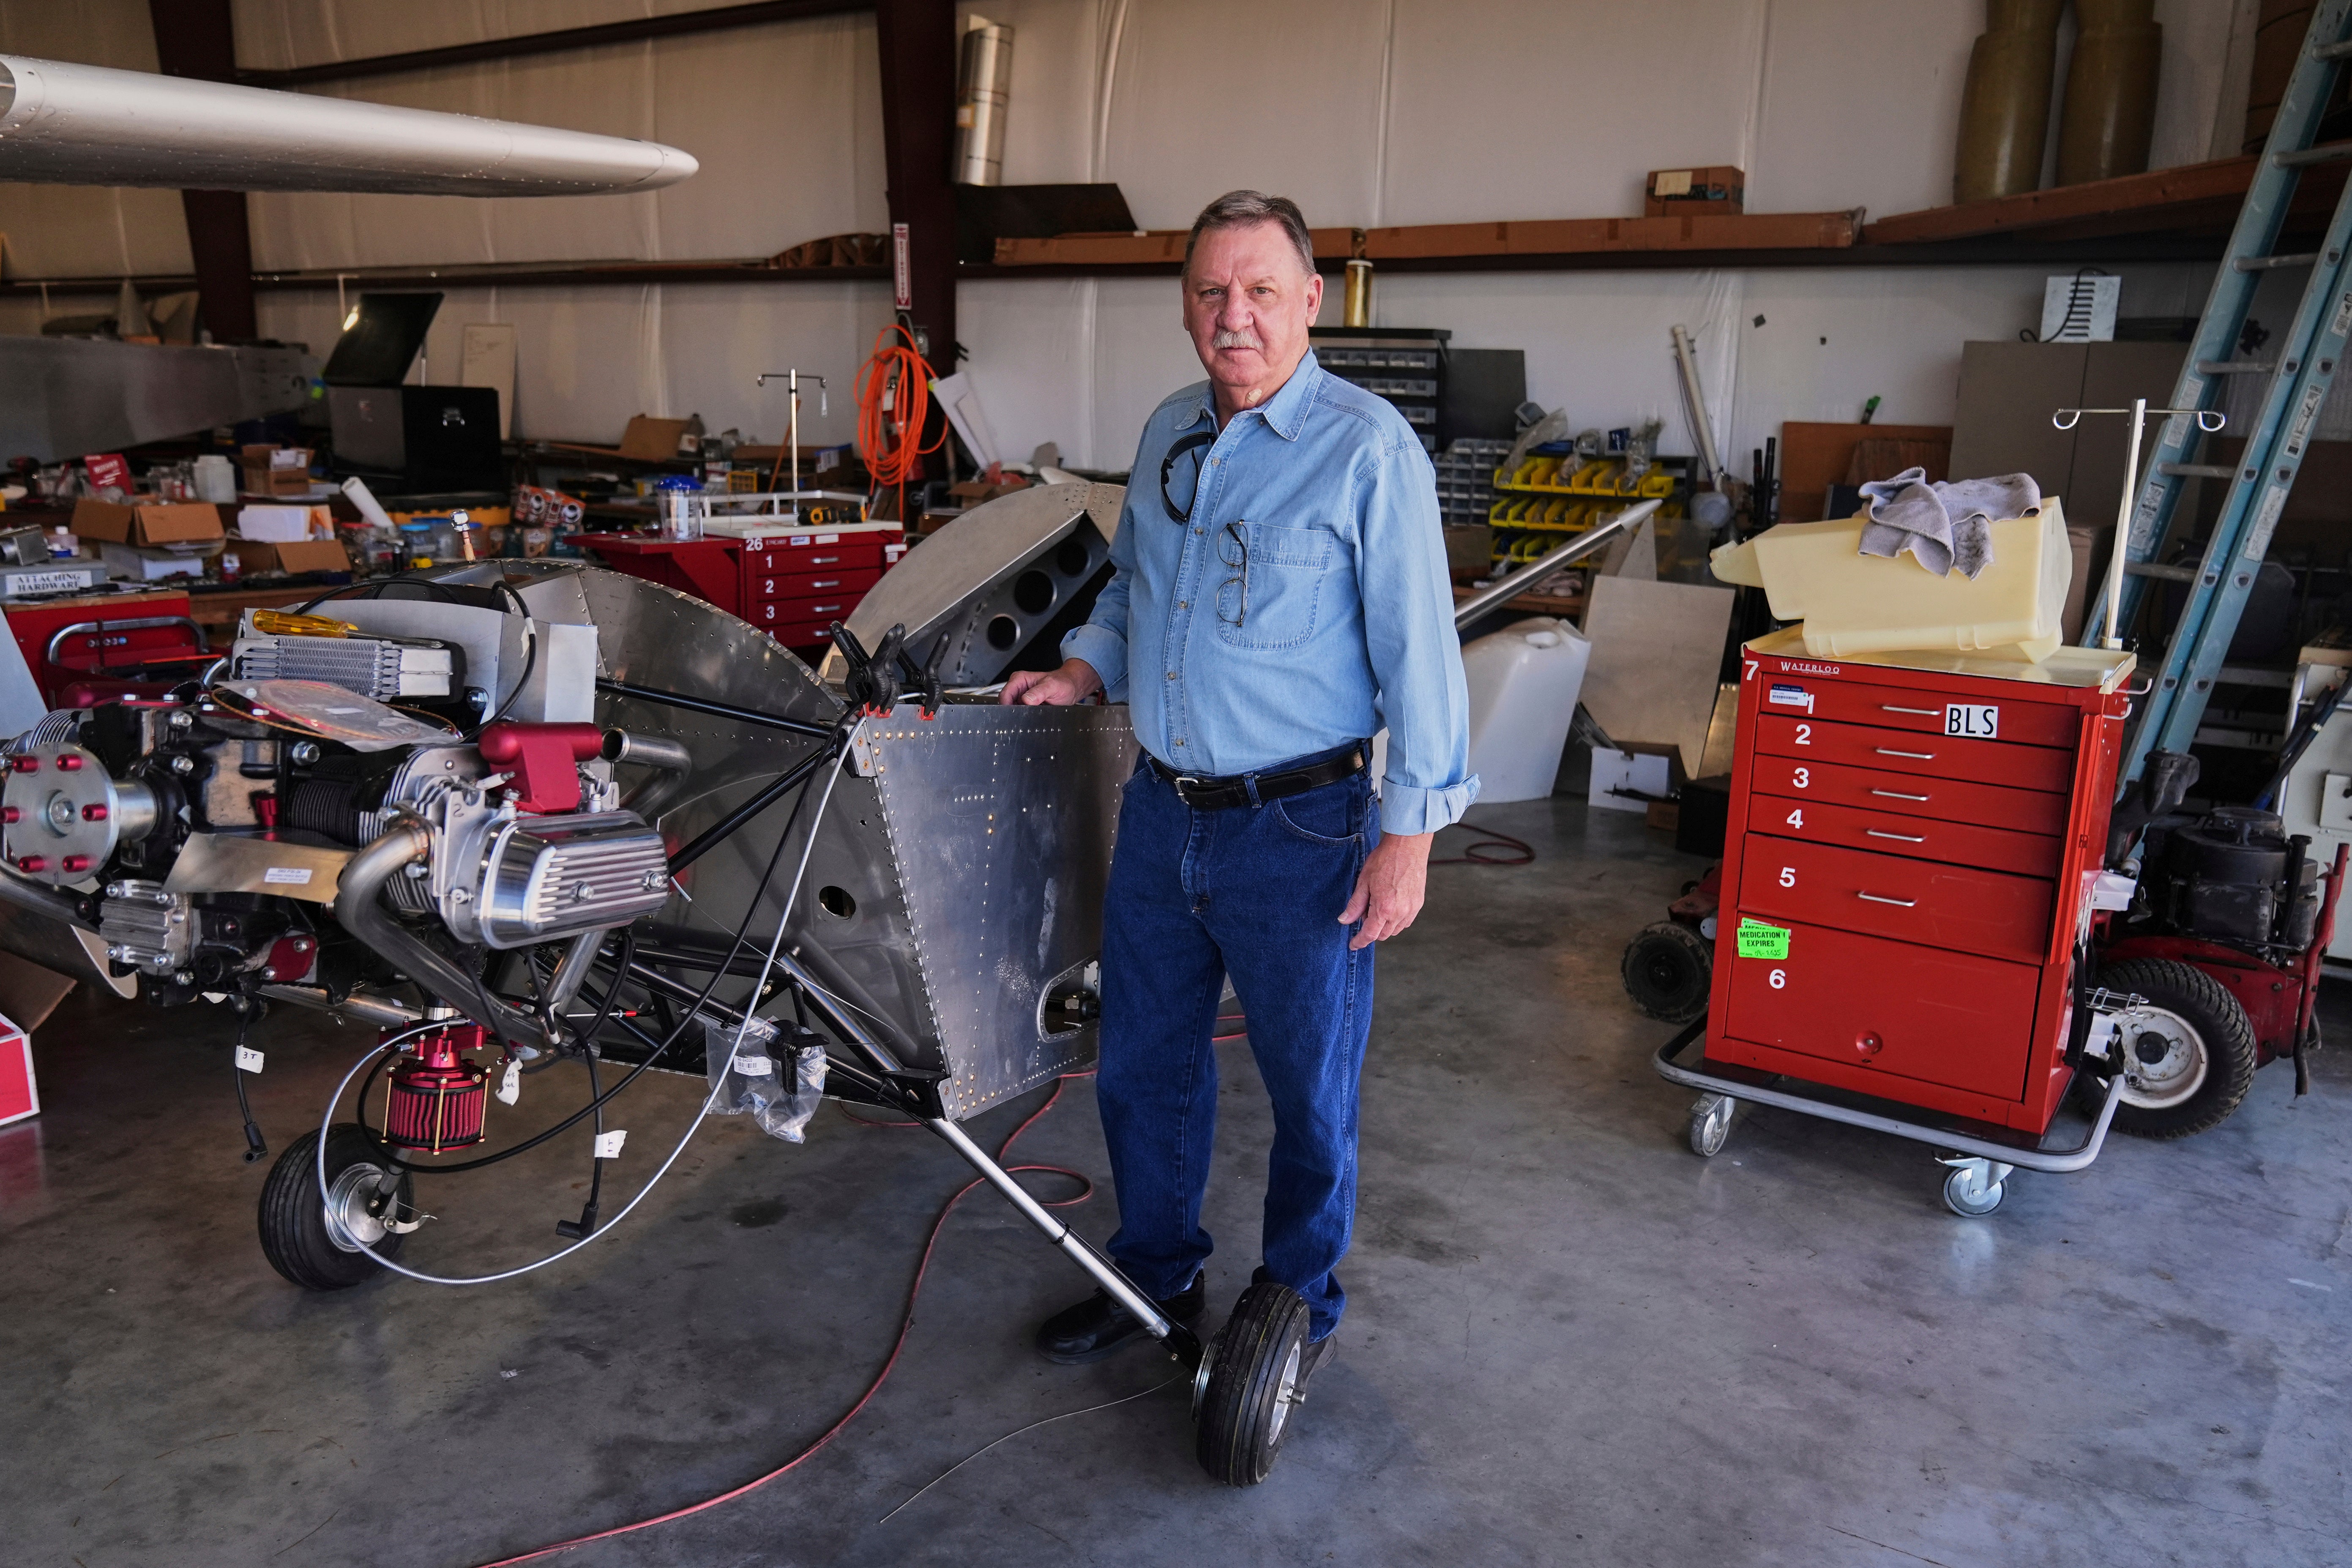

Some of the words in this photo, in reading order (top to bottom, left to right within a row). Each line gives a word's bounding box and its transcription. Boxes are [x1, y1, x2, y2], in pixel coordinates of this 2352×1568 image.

[746, 538, 763, 551] 26
[765, 555, 772, 568] 1
[18, 573, 80, 583] ATTACHING
[765, 579, 774, 593] 2
[766, 605, 775, 619] 3
[1745, 660, 1759, 680] 7
[1781, 661, 1840, 674] WATERLOO
[1808, 694, 1815, 715] 1
[1948, 708, 1994, 735] BLS
[1795, 724, 1811, 745] 2
[1793, 767, 1809, 788] 3
[1787, 809, 1803, 829] 4
[1779, 867, 1795, 887] 5
[1769, 969, 1786, 989] 6
